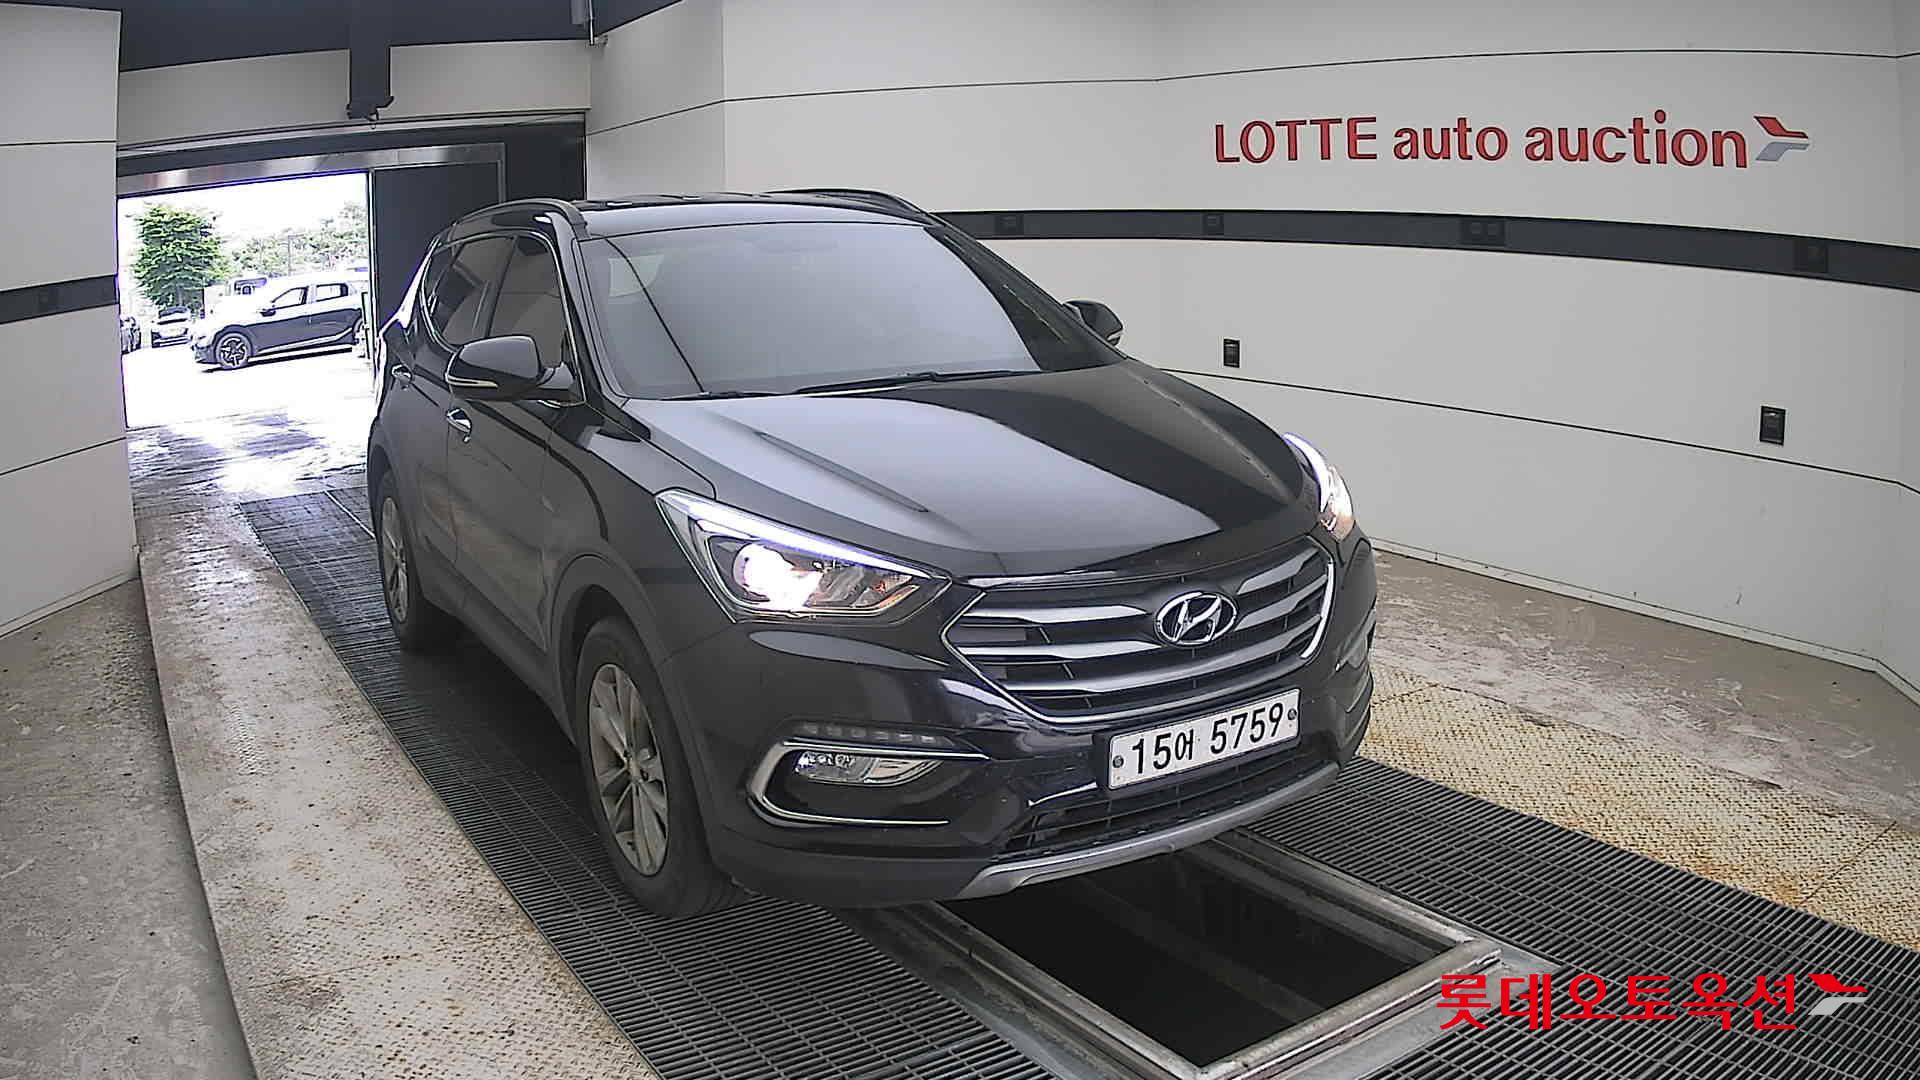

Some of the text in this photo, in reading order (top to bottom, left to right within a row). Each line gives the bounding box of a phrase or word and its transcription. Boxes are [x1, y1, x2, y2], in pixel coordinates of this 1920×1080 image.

[1214, 109, 1748, 168] LOTTE auto auction
[1131, 702, 1284, 774] 15어 5759
